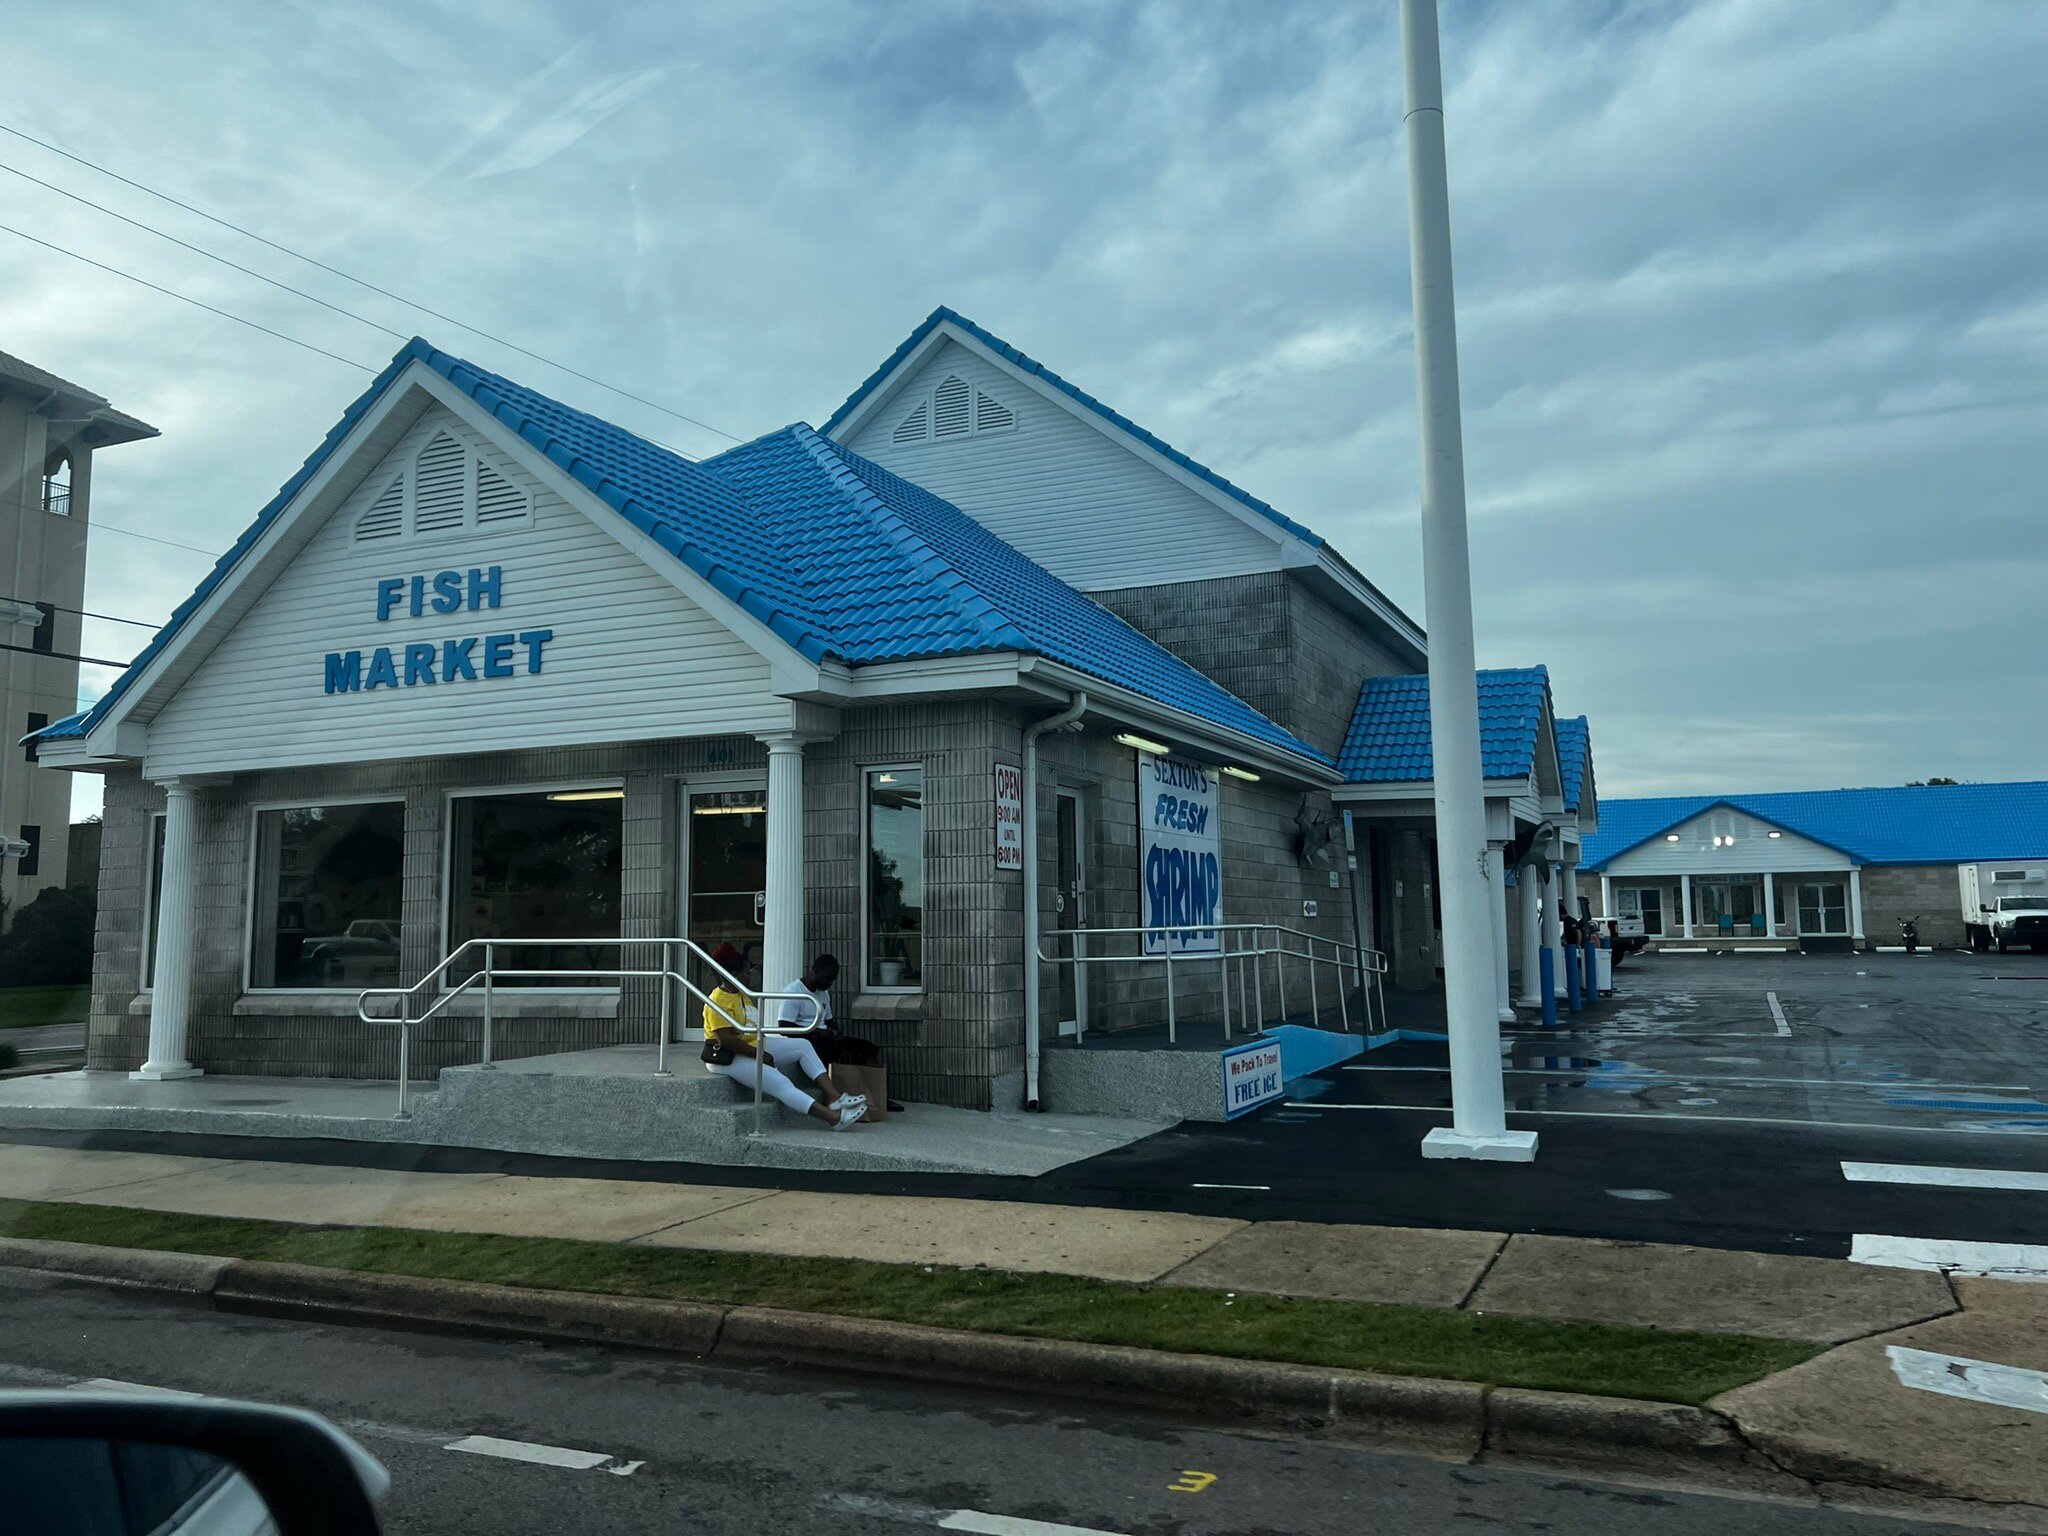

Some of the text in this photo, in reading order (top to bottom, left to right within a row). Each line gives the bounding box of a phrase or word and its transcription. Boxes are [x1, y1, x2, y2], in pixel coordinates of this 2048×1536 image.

[377, 566, 501, 621] FISH
[324, 629, 553, 694] MARKET
[998, 768, 1020, 801] OPEN
[1154, 755, 1208, 794] SEXTON'S
[1011, 807, 1020, 824] AM
[1154, 793, 1209, 835] FRESH
[1146, 842, 1219, 949] SHRIMP
[1231, 1062, 1240, 1075] We
[1242, 1056, 1255, 1073] Pack
[1256, 1055, 1263, 1068] To
[1234, 1072, 1277, 1104] FREE ICE
